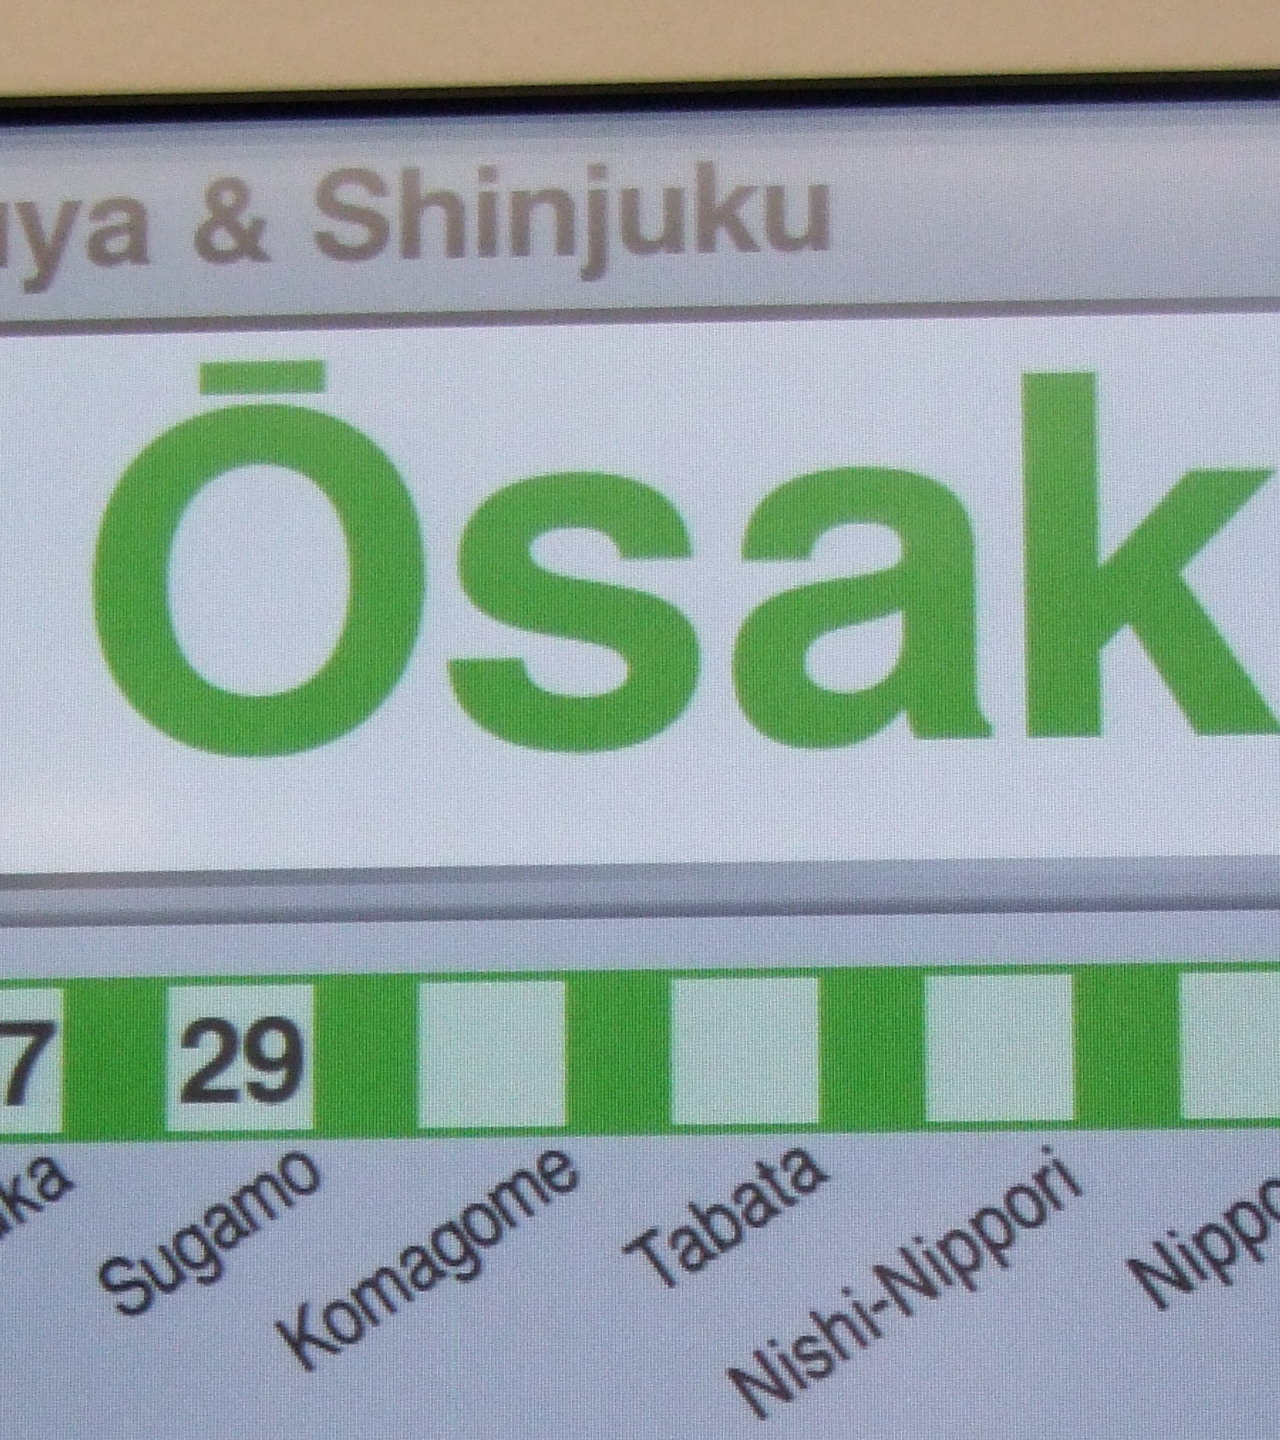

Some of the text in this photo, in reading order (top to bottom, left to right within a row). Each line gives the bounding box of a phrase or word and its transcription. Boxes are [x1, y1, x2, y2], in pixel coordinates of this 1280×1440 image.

[195, 175, 270, 266] &
[313, 162, 833, 282] Shinjuku
[179, 1015, 305, 1107] 29
[97, 1147, 325, 1318] Sugamo
[277, 1146, 582, 1372] Komagome
[623, 1145, 829, 1292] Tabata
[728, 1147, 1086, 1419] Nishi-Nippori
